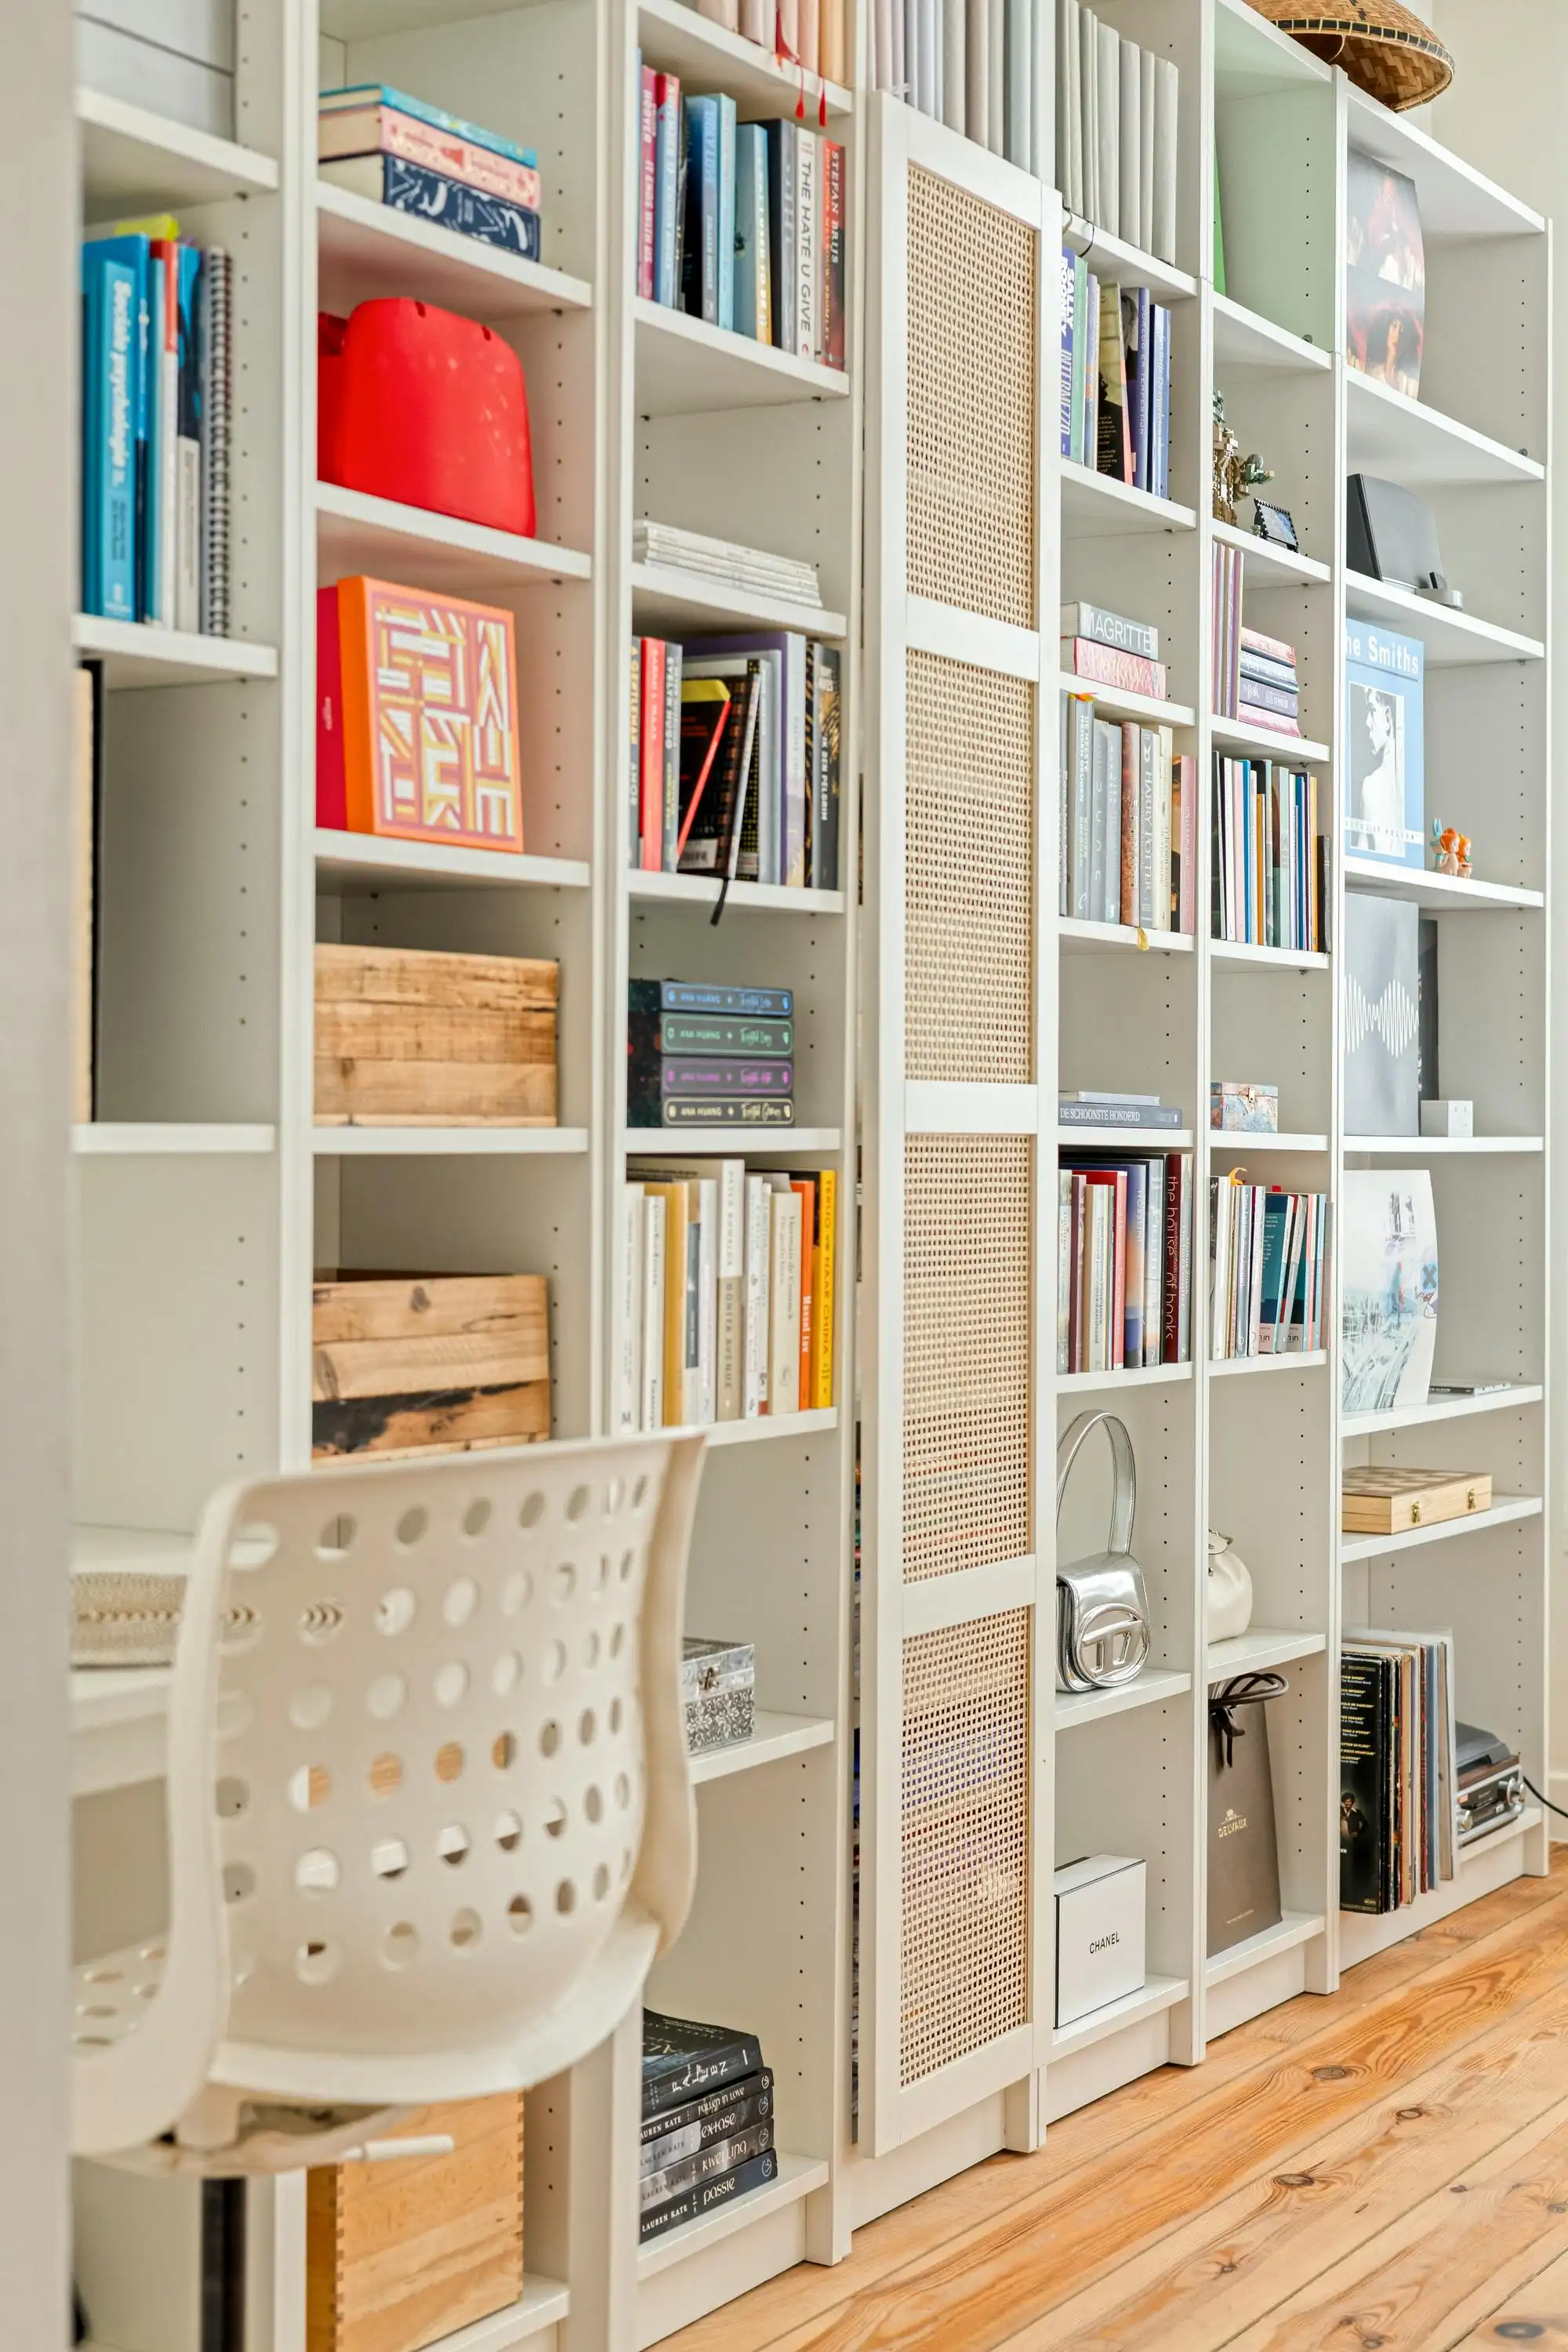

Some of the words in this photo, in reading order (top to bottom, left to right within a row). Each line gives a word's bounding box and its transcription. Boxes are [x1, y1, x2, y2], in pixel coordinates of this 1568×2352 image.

[800, 161, 812, 201] THE
[831, 150, 840, 214] STEFAN
[800, 205, 811, 258] HATE
[829, 220, 839, 264] BRIJS
[800, 263, 811, 278] U
[800, 284, 811, 332] GIVE
[1066, 267, 1075, 331] SALLY
[1141, 354, 1147, 368] EN
[1061, 348, 1073, 435] INTERMEZZO
[1139, 372, 1148, 435] TERPENTIJN
[1084, 611, 1152, 652] MAGRITTE
[1368, 635, 1418, 674] Smiths
[821, 750, 830, 773] BEN
[820, 775, 829, 821] PELGRIM
[1145, 771, 1154, 827] HARRY
[1145, 832, 1154, 892] POTTER
[1060, 1107, 1069, 1119] DE
[1069, 1108, 1109, 1120] SCHOONSTE
[1109, 1110, 1141, 1122] HONDERD
[1167, 1175, 1178, 1201] the
[1167, 1207, 1178, 1255] house
[1167, 1272, 1178, 1289] of
[1167, 1292, 1178, 1339] books
[724, 1338, 733, 1391] AVENUE
[1218, 1818, 1248, 1838] DELVAUX
[1089, 1932, 1120, 1955] CHANEL
[641, 2126, 662, 2140] AUREN
[664, 2116, 683, 2129] KATE
[641, 2151, 666, 2167] LAUREN
[667, 2140, 685, 2153] KATE
[641, 2213, 668, 2233] LAUREN
[670, 2204, 688, 2219] KATE
